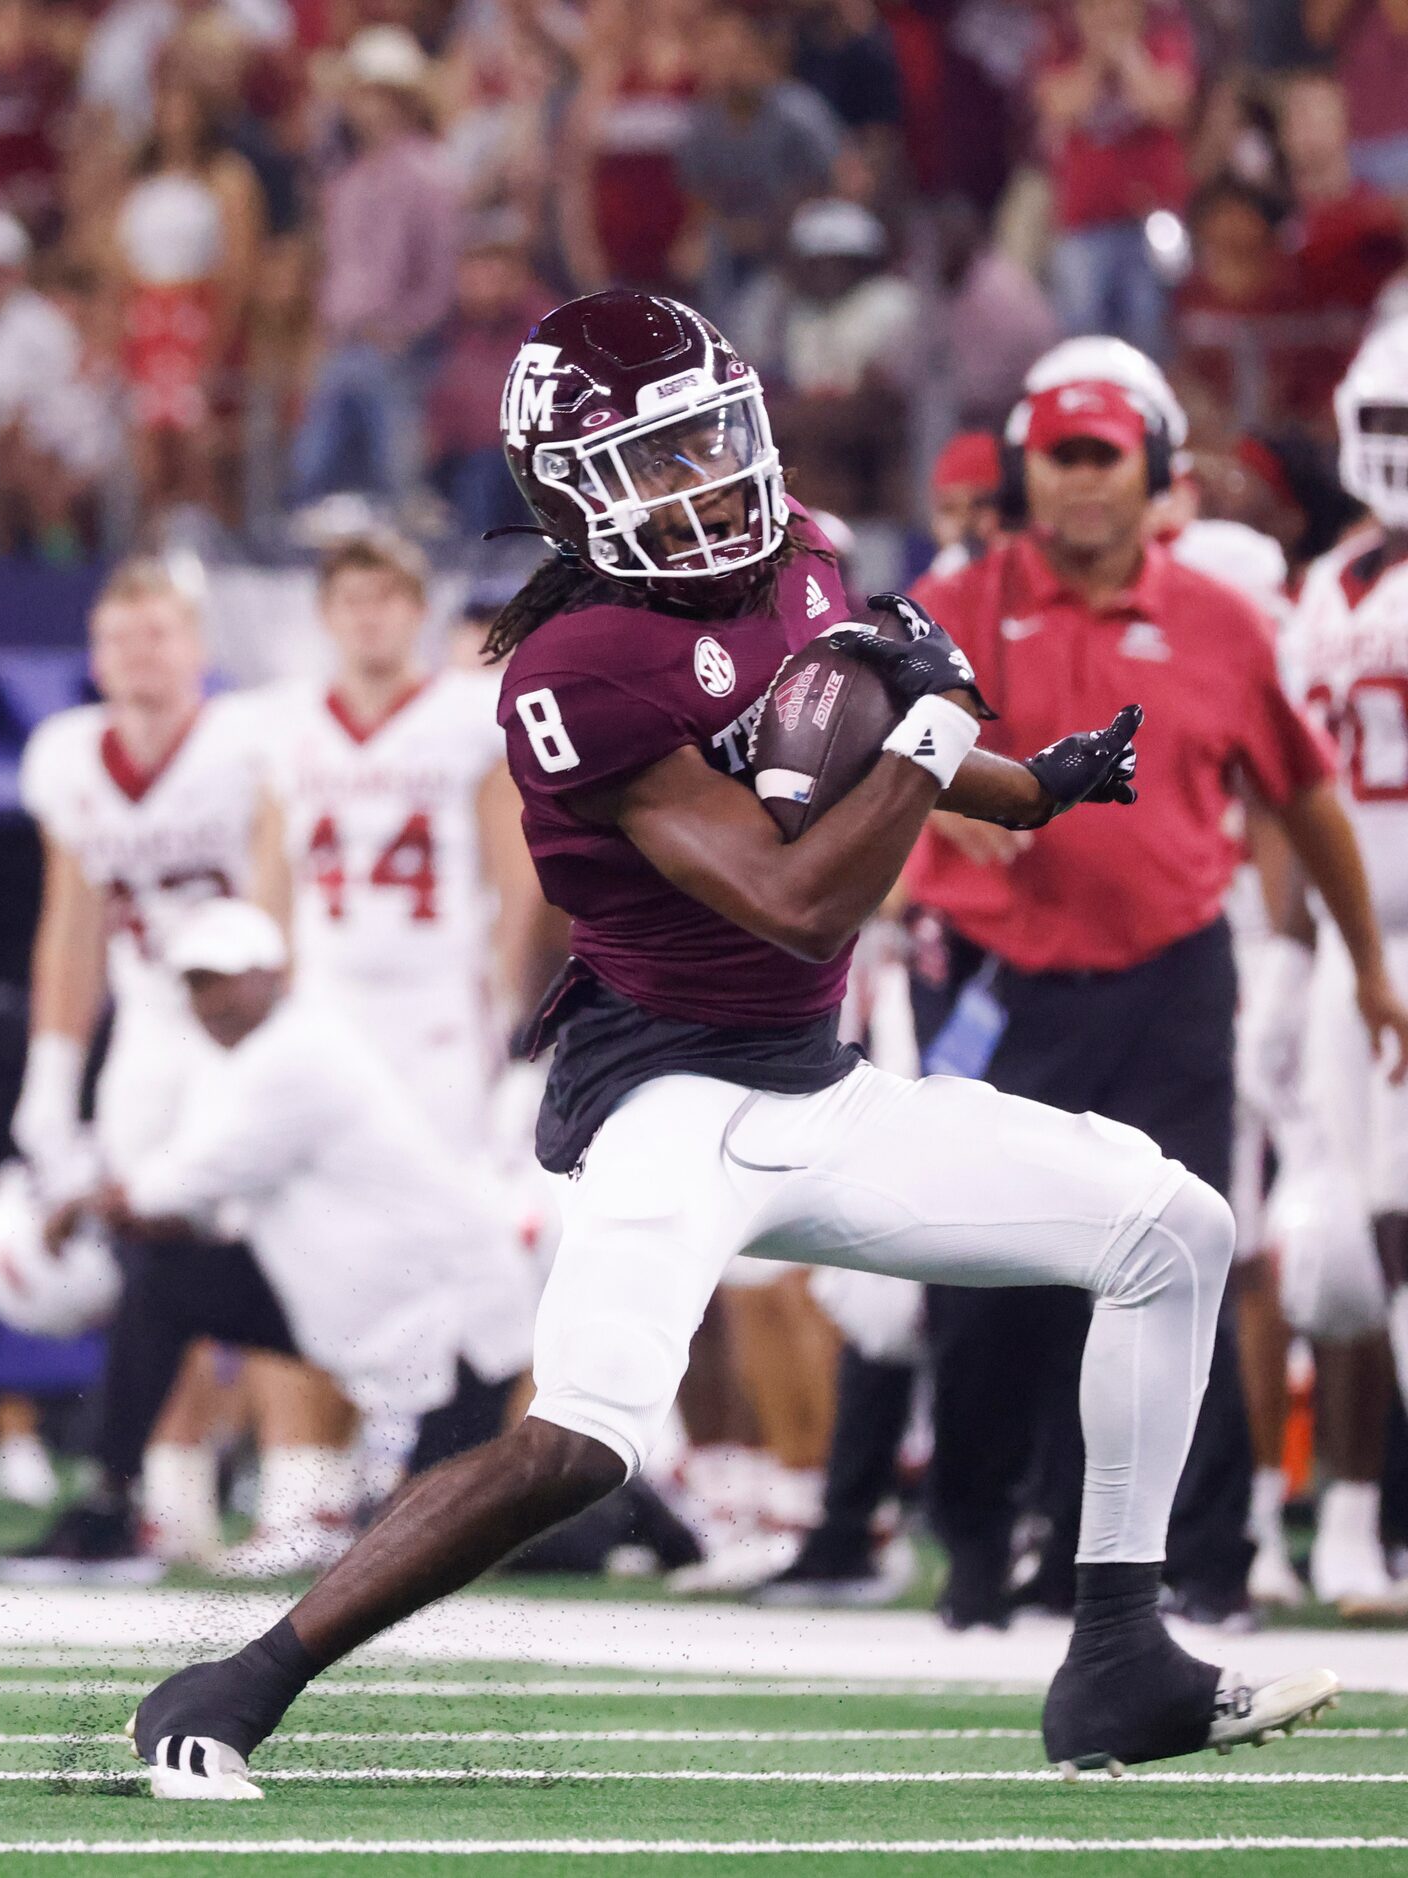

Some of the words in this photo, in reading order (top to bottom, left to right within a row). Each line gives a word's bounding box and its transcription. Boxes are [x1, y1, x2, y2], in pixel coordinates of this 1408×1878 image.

[657, 374, 698, 399] AGGIES
[784, 662, 821, 731] adidas
[811, 670, 845, 731] DIME
[515, 687, 581, 773] 8
